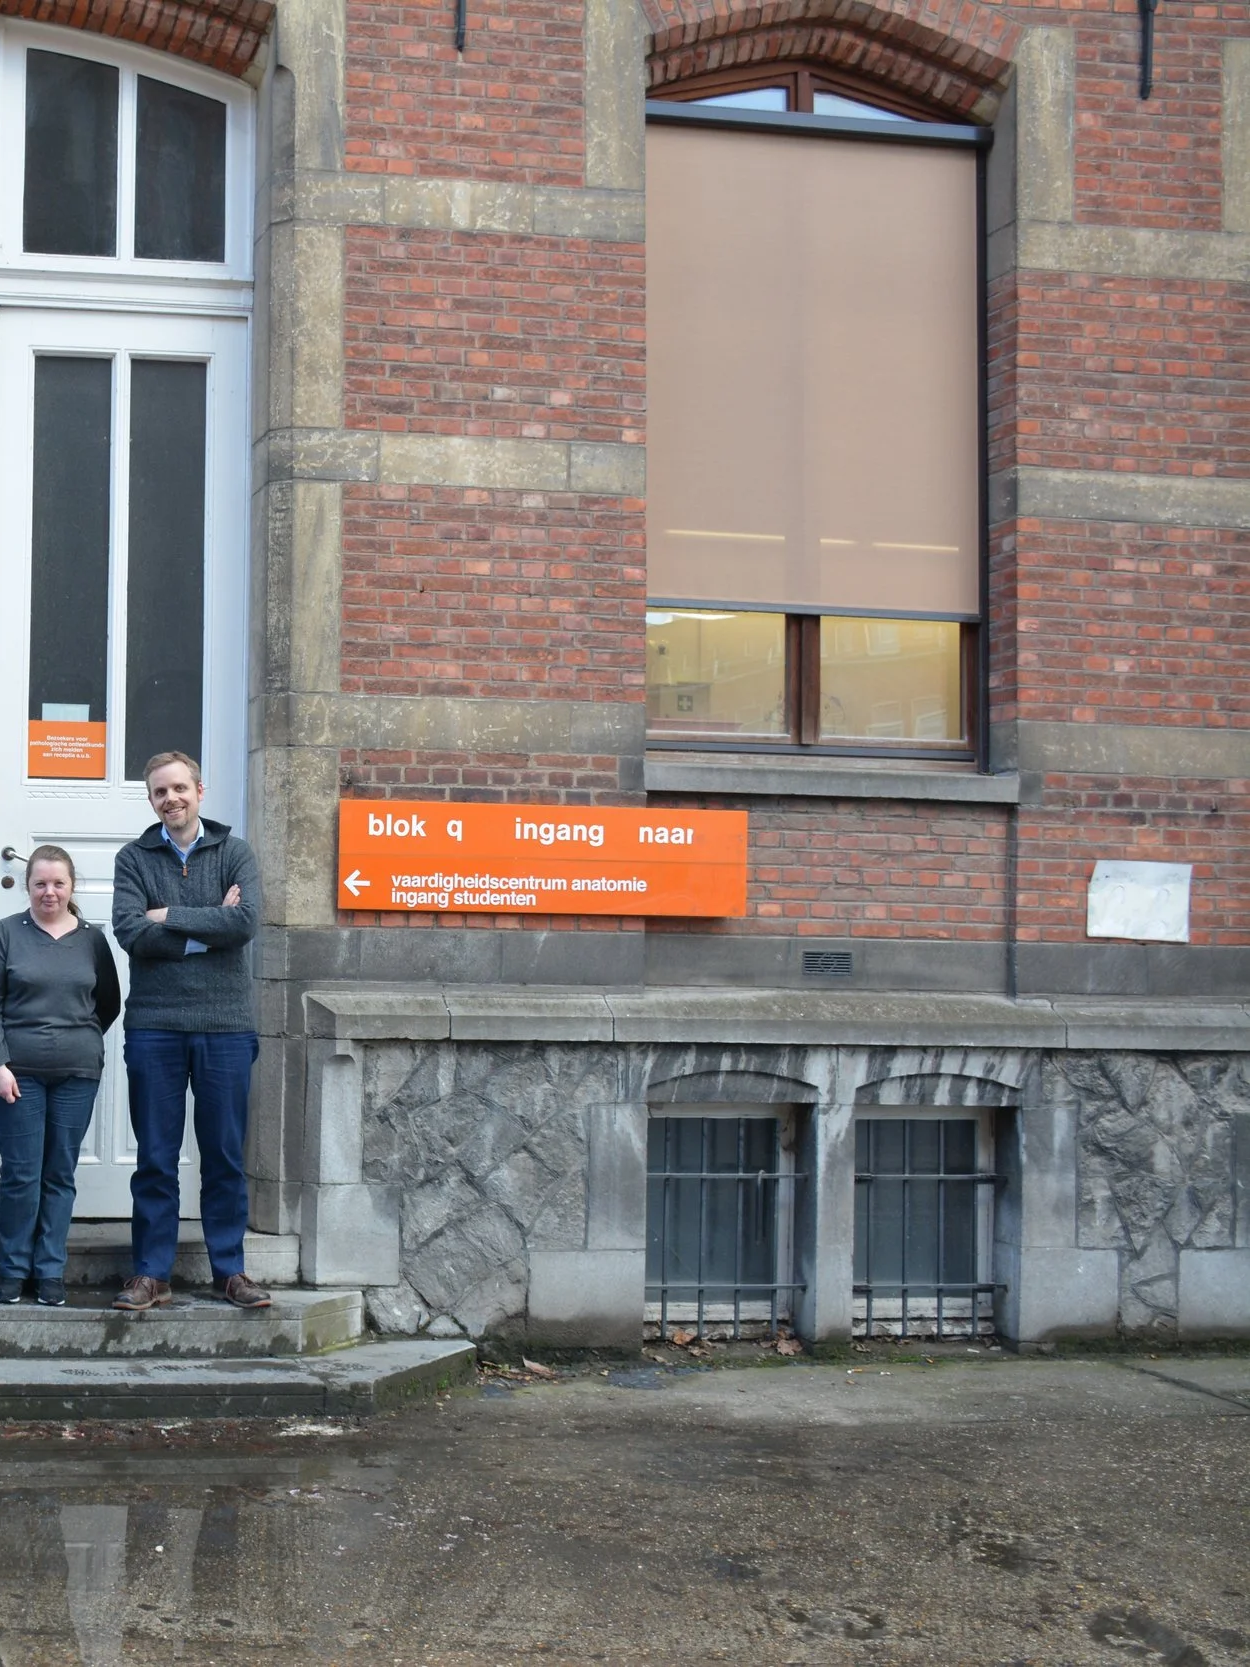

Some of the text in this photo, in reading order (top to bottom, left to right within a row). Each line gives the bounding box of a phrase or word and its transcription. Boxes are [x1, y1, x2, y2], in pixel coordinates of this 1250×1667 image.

[368, 813, 694, 847] blok q ingang naar
[391, 872, 648, 892] vaardigheidscentrum anatomie
[391, 888, 537, 908] ingang studenten
